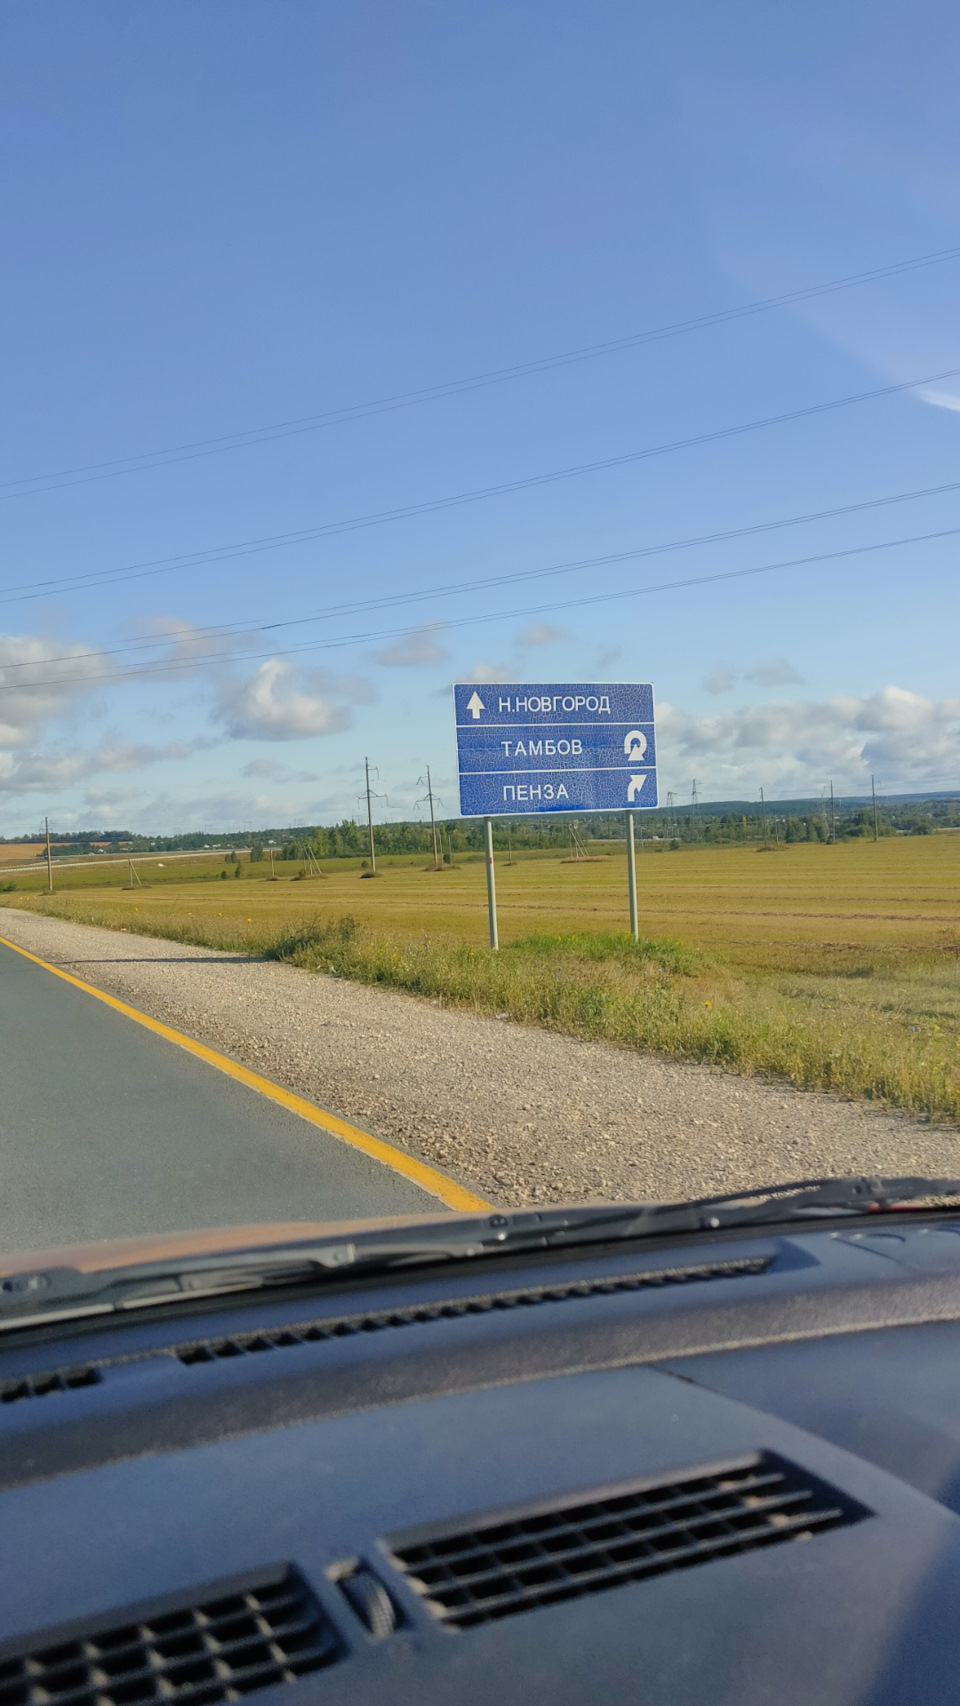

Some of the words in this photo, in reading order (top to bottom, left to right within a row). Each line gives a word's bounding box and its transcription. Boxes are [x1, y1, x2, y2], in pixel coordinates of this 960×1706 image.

[498, 696, 611, 714] Н.НОВГОРОД
[501, 739, 583, 757] ТАМБОВ
[503, 783, 569, 801] ПЕНЗА
